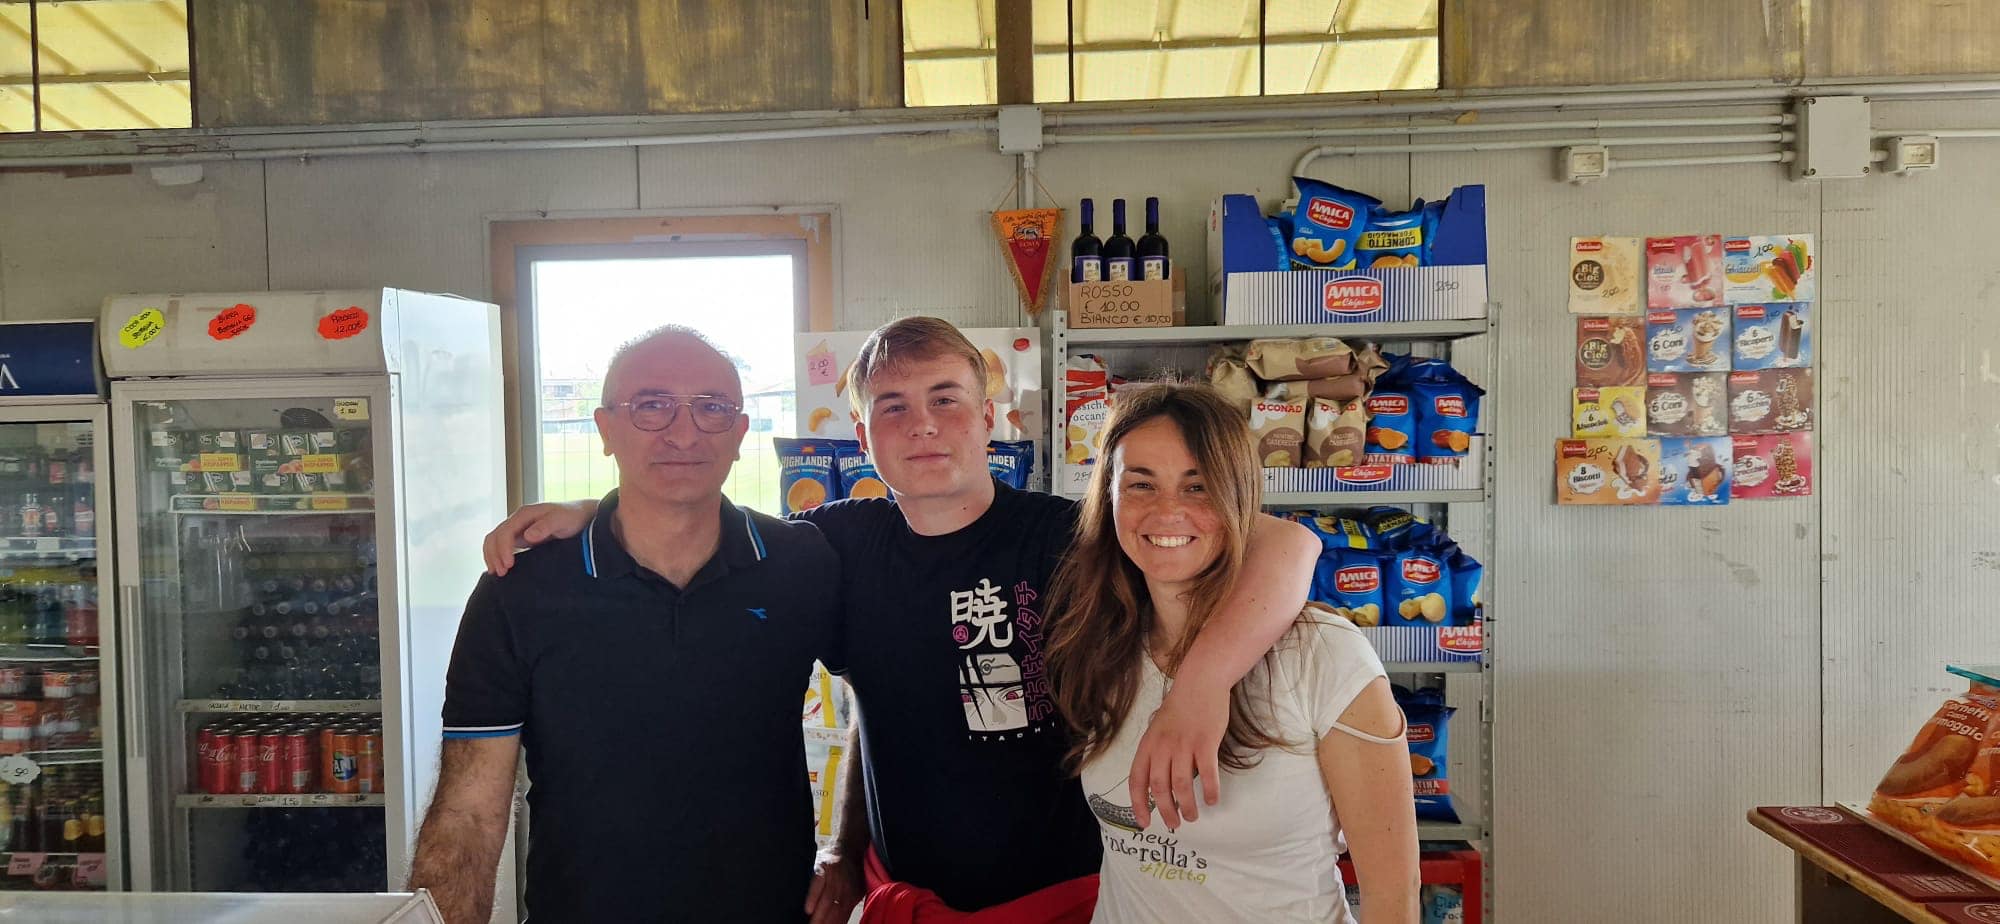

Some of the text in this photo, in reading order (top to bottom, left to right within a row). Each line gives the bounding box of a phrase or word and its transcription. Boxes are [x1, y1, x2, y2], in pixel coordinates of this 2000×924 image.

[1311, 201, 1351, 221] AMICA
[1368, 237, 1415, 249] CORNETTO
[1581, 263, 1600, 275] Big
[1080, 284, 1133, 299] ROSSO
[1328, 285, 1380, 299] AMICA
[1100, 300, 1140, 313] 10,00
[1342, 298, 1366, 309] Chips
[1080, 313, 1129, 325] BIANCO
[1267, 404, 1303, 413] CONAD
[1369, 399, 1406, 407] AMICA
[782, 456, 832, 471] HIGHLANDER
[988, 455, 1016, 470] ANDER
[1339, 571, 1378, 584] AMICA
[950, 577, 1015, 650] 暁
[1440, 625, 1482, 638] AMIC
[1132, 831, 1178, 846] new
